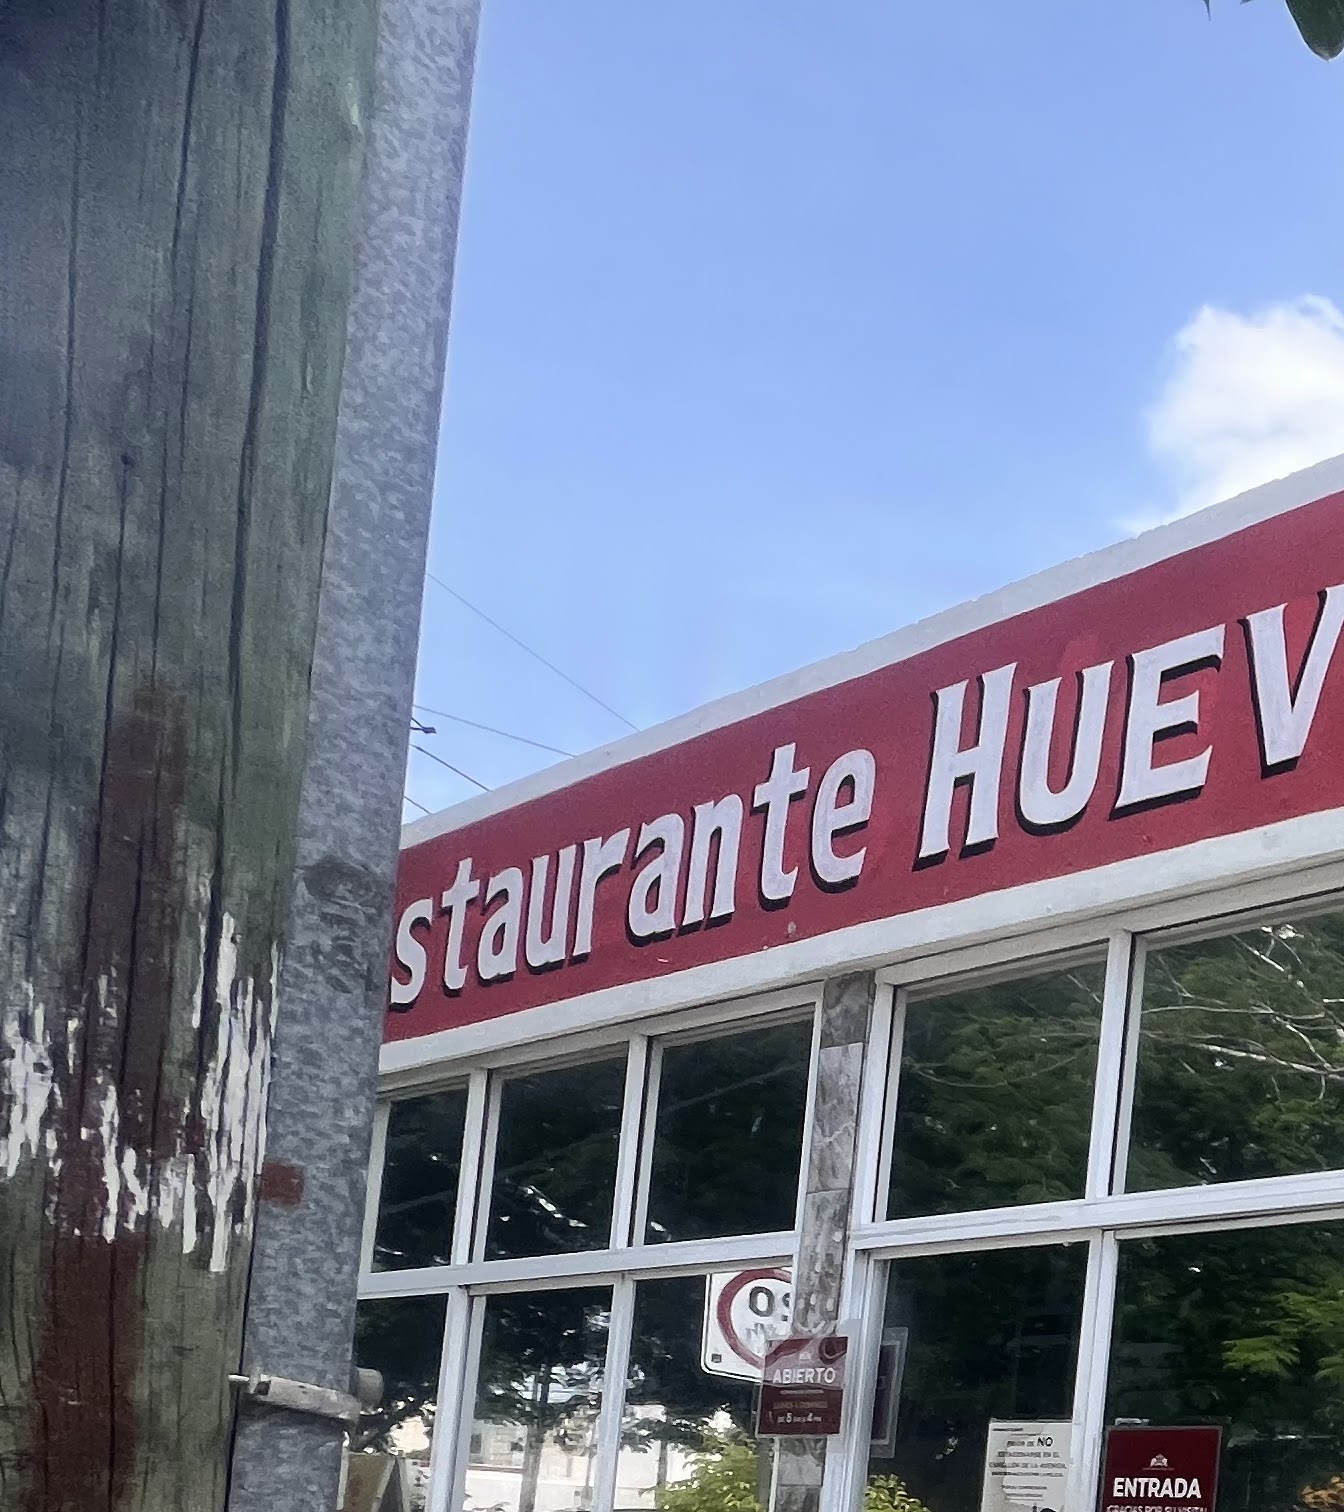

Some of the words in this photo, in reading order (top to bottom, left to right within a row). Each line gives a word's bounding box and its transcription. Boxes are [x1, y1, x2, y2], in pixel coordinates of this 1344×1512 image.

[772, 1367, 837, 1384] ABIERTO
[1037, 1436, 1054, 1447] NO
[1113, 1477, 1202, 1499] ENTRADA
